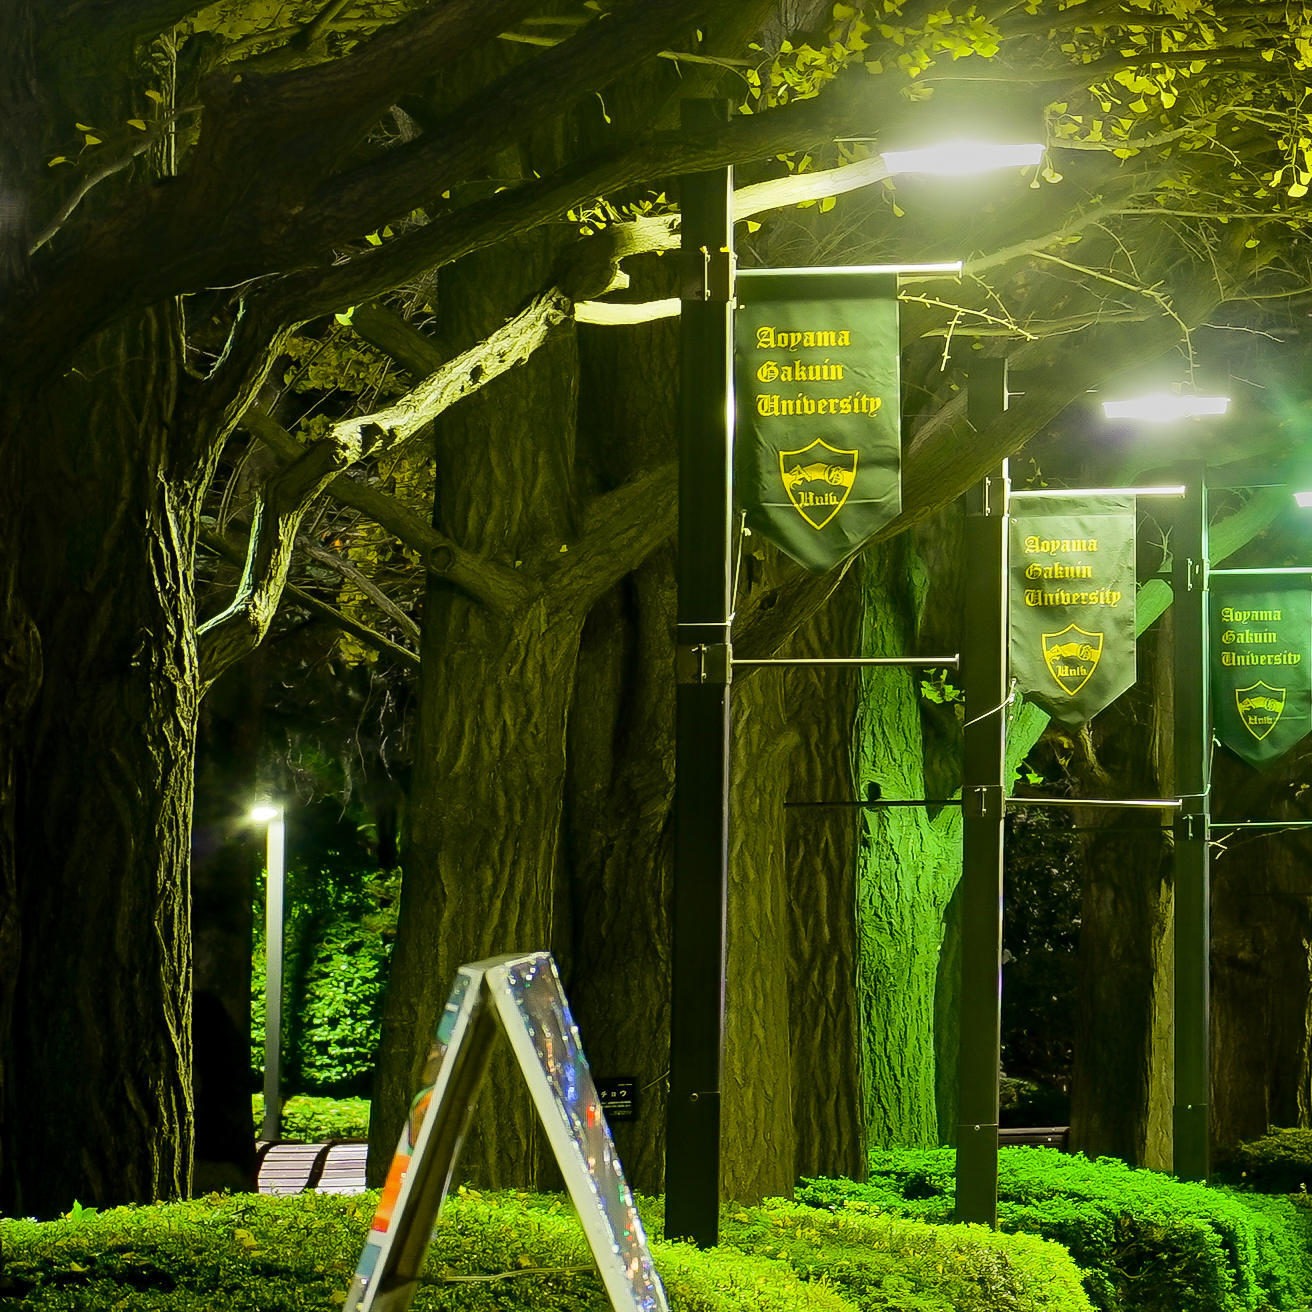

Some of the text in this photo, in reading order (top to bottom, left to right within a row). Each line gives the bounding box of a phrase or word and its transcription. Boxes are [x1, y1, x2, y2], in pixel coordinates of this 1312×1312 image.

[756, 326, 851, 352] Aoyama
[756, 358, 845, 383] Gakuin
[755, 391, 882, 418] University
[1024, 535, 1099, 556] Aoyama
[1024, 561, 1093, 580] Gakuin
[1024, 587, 1123, 608] University
[1221, 607, 1282, 625] Aoyama
[1221, 628, 1277, 645] Gakuin
[1220, 650, 1302, 667] University
